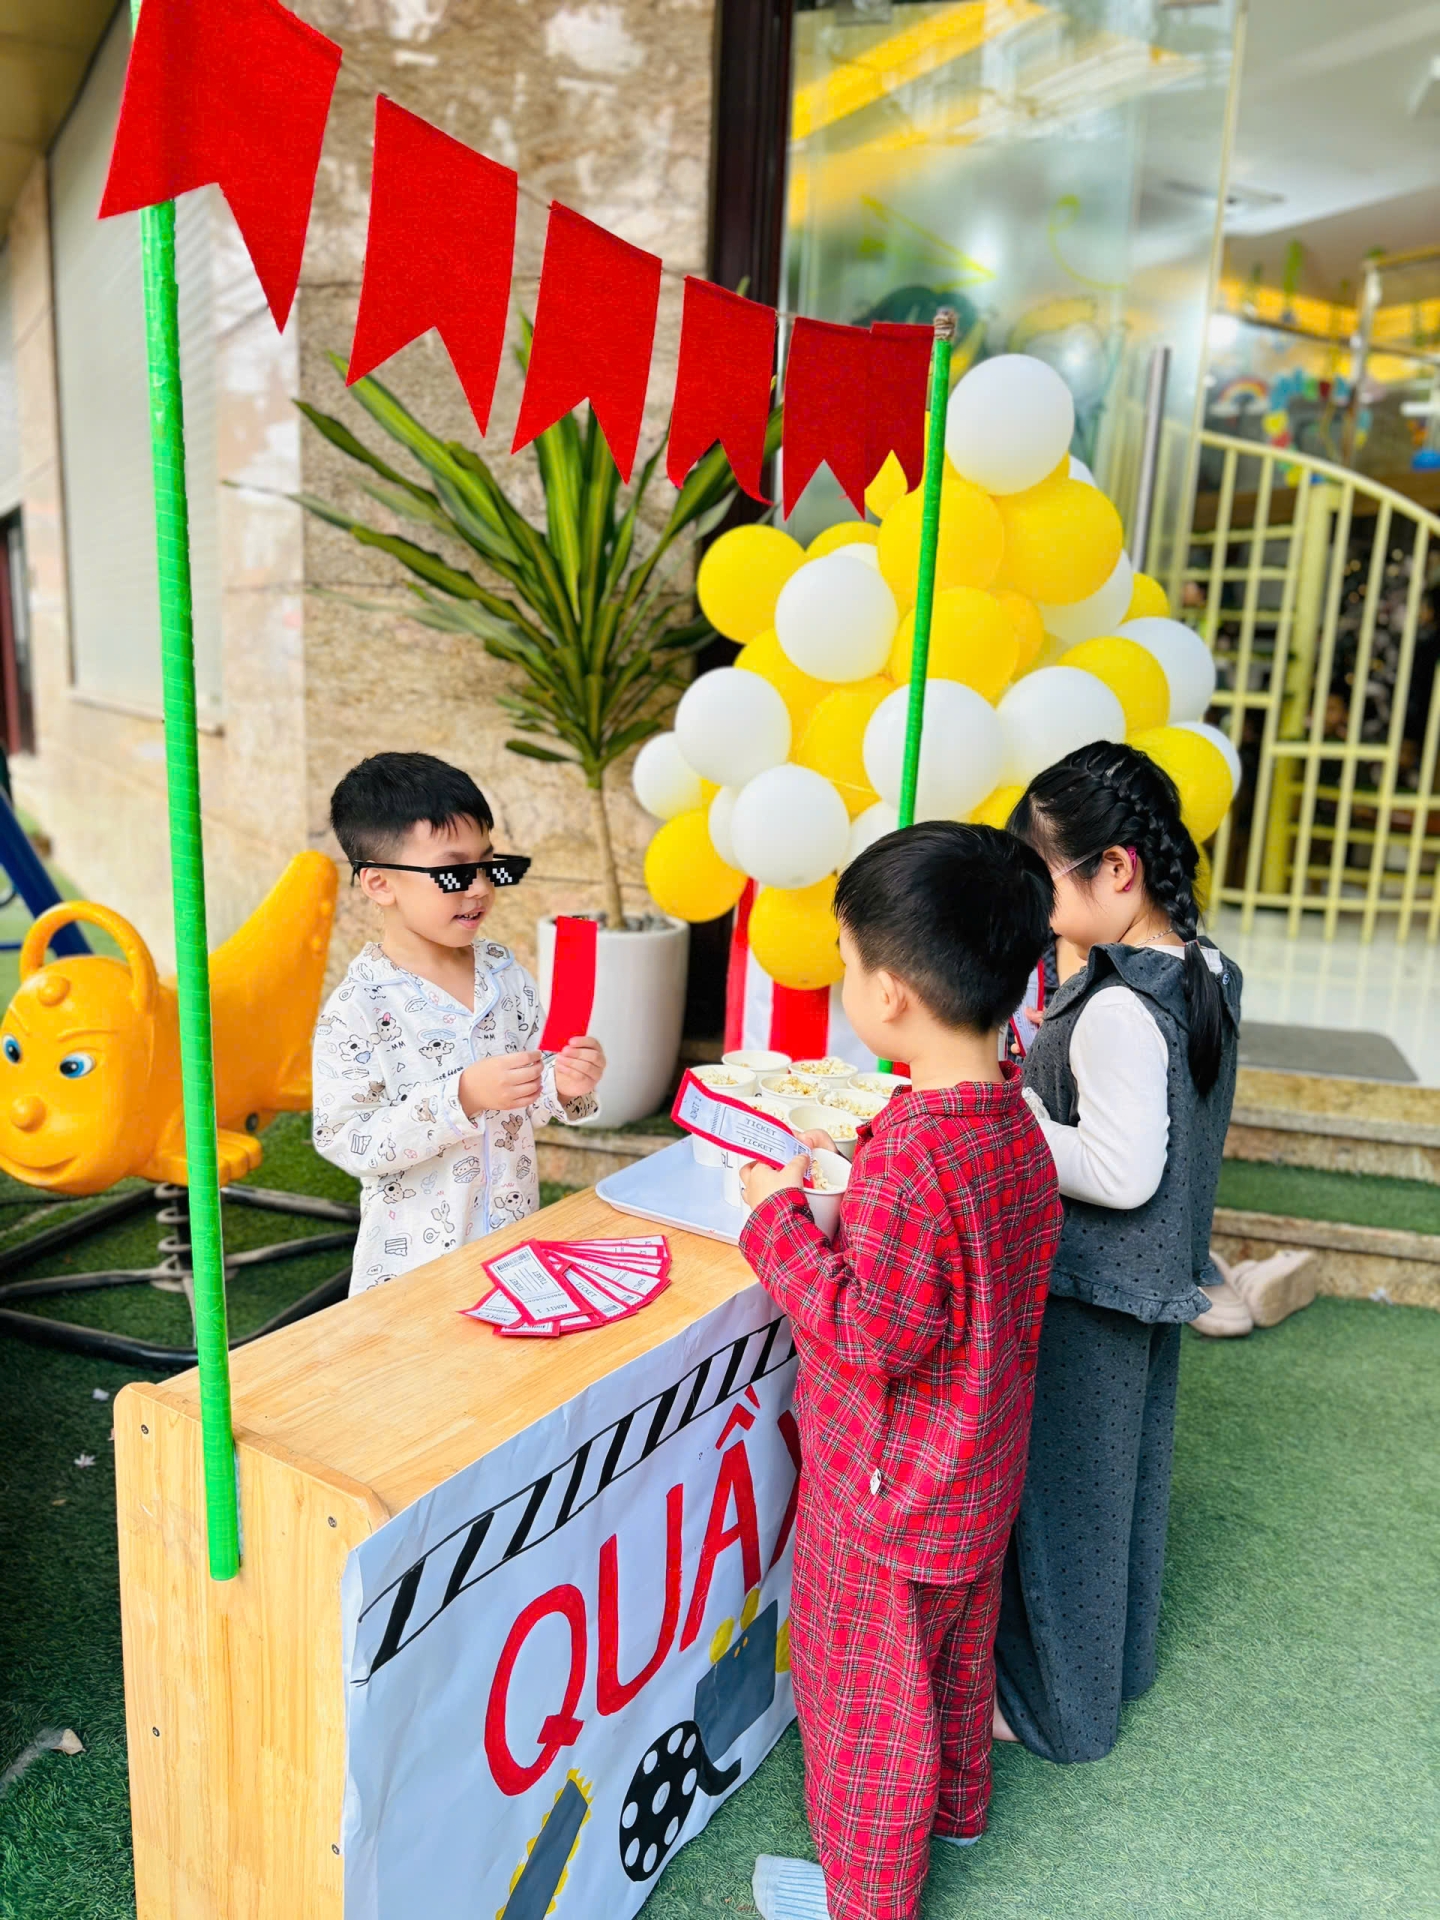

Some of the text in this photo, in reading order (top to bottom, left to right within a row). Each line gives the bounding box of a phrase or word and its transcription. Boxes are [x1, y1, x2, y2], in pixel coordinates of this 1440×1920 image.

[745, 1117, 777, 1136] TICKET
[742, 1137, 774, 1153] TICKET
[509, 1278, 526, 1292] TICKET
[532, 1270, 548, 1285] TICKET
[575, 1281, 598, 1298] TICKET
[546, 1303, 568, 1312] ADMIT
